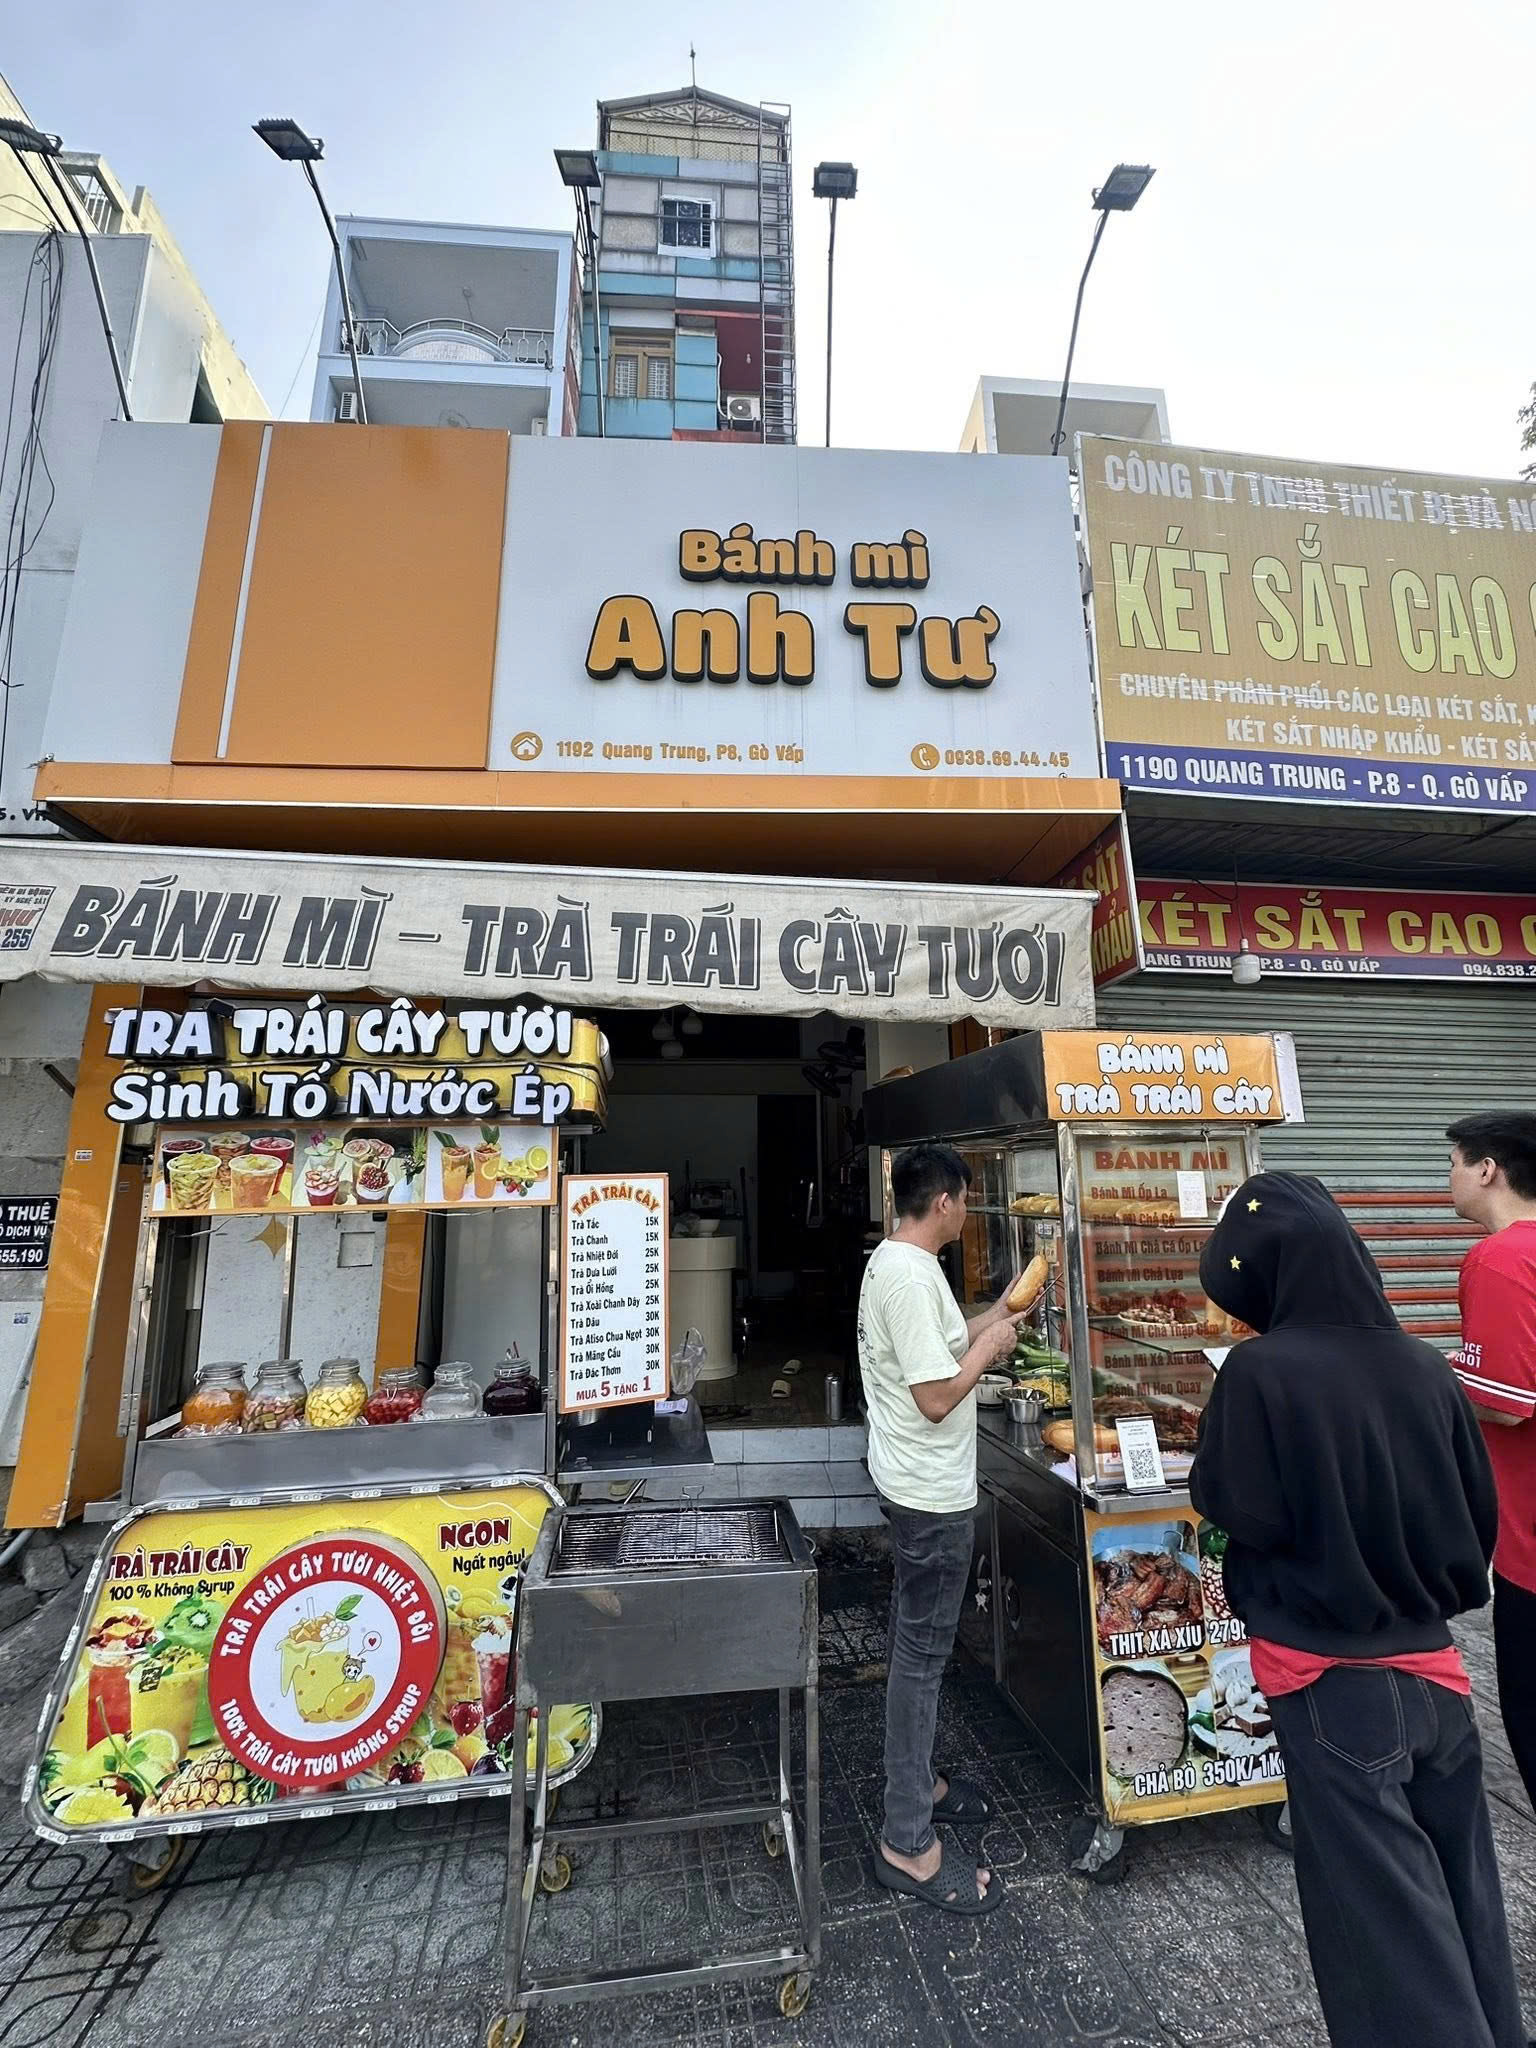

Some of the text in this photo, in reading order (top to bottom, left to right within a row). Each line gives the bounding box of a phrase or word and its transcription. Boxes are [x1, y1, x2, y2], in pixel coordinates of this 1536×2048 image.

[1104, 450, 1193, 499] CÔNG
[1199, 466, 1234, 503] TY
[1333, 477, 1415, 522] THIẾT
[679, 523, 930, 589] Bánh mì
[1110, 526, 1231, 655] KÉT
[1251, 523, 1373, 668] SẮT
[1390, 569, 1518, 679] CAO
[585, 591, 1001, 689] Anh Tư
[1120, 673, 1209, 701] CHUYÊN
[1213, 678, 1275, 706] PHÂN
[1279, 680, 1330, 710] PHỐI
[1336, 686, 1379, 715] CÁC
[1384, 693, 1432, 722] LOẠI
[1436, 694, 1474, 721] KÉT
[1479, 693, 1523, 727] SẮT,
[1226, 715, 1498, 760] KÉT SẮT NHẬP KHẨU KÉT
[556, 741, 804, 763] 1192 Quang Trung, P8, Gò Vấp
[944, 749, 1070, 767] 0938.69.44.45
[1120, 755, 1528, 802] 1190 QUANG TRUNG P.8 Q. GÒ VẤP
[1139, 892, 1232, 947] KÉT
[1254, 891, 1366, 952] SẮT
[1387, 910, 1503, 956] CAO
[1, 928, 32, 947] 255
[50, 873, 1066, 1008] BÁNH MÌ TRÀ TRÁI CÂY TƯƠI
[1261, 957, 1380, 973] P.8 Q. GÒ VẤP
[232, 992, 573, 1057] TRÁI CÂY TƯƠI
[1097, 1035, 1230, 1075] BÁNH MÌ
[105, 1060, 574, 1126] Sinh Tố Nước Ép
[1055, 1074, 1273, 1114] TRÀ TRÁI CÂY
[1095, 1146, 1228, 1170] BÁNH MÌ
[570, 1181, 660, 1216] TRÀ TRÁI CÂY
[1091, 1186, 1119, 1199] Bánh
[1122, 1187, 1135, 1199] Mì
[1155, 1187, 1168, 1199] La
[8, 1202, 51, 1221] THUÊ
[572, 1216, 659, 1230] Trà 15K
[6, 1226, 31, 1239] DỊCH
[34, 1225, 48, 1239] VỤ
[572, 1232, 659, 1246] Trà Chanh 15K
[571, 1253, 584, 1262] Trà
[645, 1247, 659, 1257] 25K
[571, 1269, 584, 1278] Trà
[645, 1263, 659, 1273] 25K
[571, 1279, 659, 1295] Trà 25K
[571, 1302, 583, 1312] Trà
[603, 1298, 625, 1309] Chanh
[645, 1295, 659, 1305] 25K
[571, 1319, 583, 1329] Trà
[645, 1311, 660, 1321] 30K
[571, 1336, 583, 1346] Trà
[606, 1331, 624, 1342] Chua
[626, 1329, 642, 1341] Ngọt
[645, 1327, 660, 1338] 30K
[570, 1352, 583, 1363] Trà
[646, 1343, 660, 1354] 30K
[570, 1360, 660, 1380] Trà Thơm 30K
[576, 1389, 597, 1401] MUA
[601, 1381, 610, 1397] 5
[643, 1375, 651, 1391] 1
[1176, 1380, 1202, 1396] Quay
[439, 1517, 511, 1552] NGON
[106, 1539, 252, 1581] TRÀ TRÁI CÂY
[453, 1553, 486, 1576] Ngất
[109, 1579, 235, 1601] 100 % Không Syrup
[220, 1549, 420, 1657] TRÀ TRÁI CÂY TƯƠI NHIỆT
[1109, 1621, 1202, 1659] THỊT XÁ XÍU
[219, 1683, 422, 1777] 100% TRÁI CÂY TƯƠI KHÔNG SYRUP
[1133, 1764, 1168, 1797] CHẢ
[1172, 1761, 1196, 1790] BÒ
